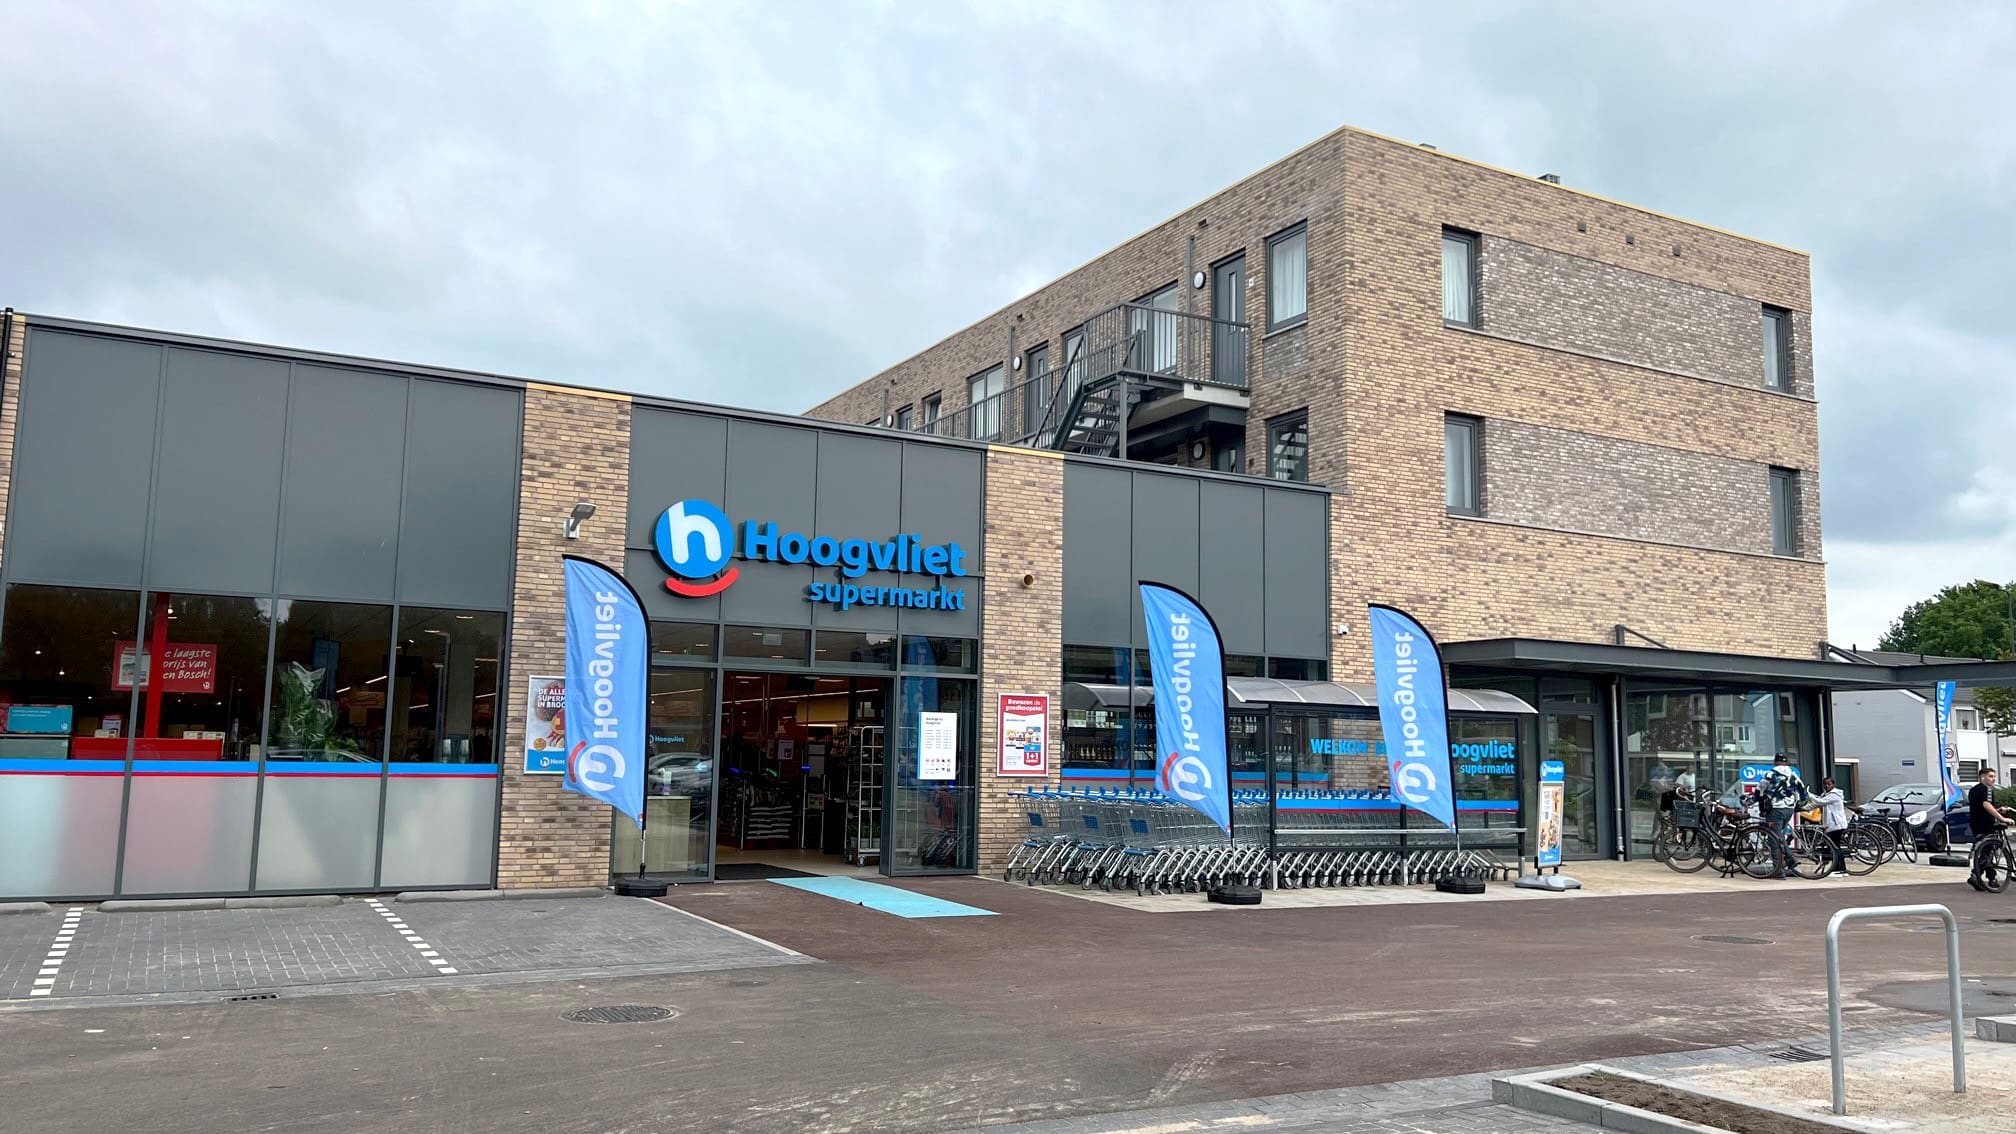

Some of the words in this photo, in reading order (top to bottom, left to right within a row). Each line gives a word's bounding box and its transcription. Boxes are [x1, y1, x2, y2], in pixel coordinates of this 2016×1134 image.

[742, 519, 968, 577] Hoogvliet
[808, 581, 966, 611] supermarkt
[173, 648, 211, 660] laagste
[189, 660, 208, 668] van
[177, 668, 211, 679] Bosch!
[1310, 738, 1368, 754] WELKOM
[1451, 739, 1515, 762] oogvliet
[1460, 761, 1515, 776] supermarkt
